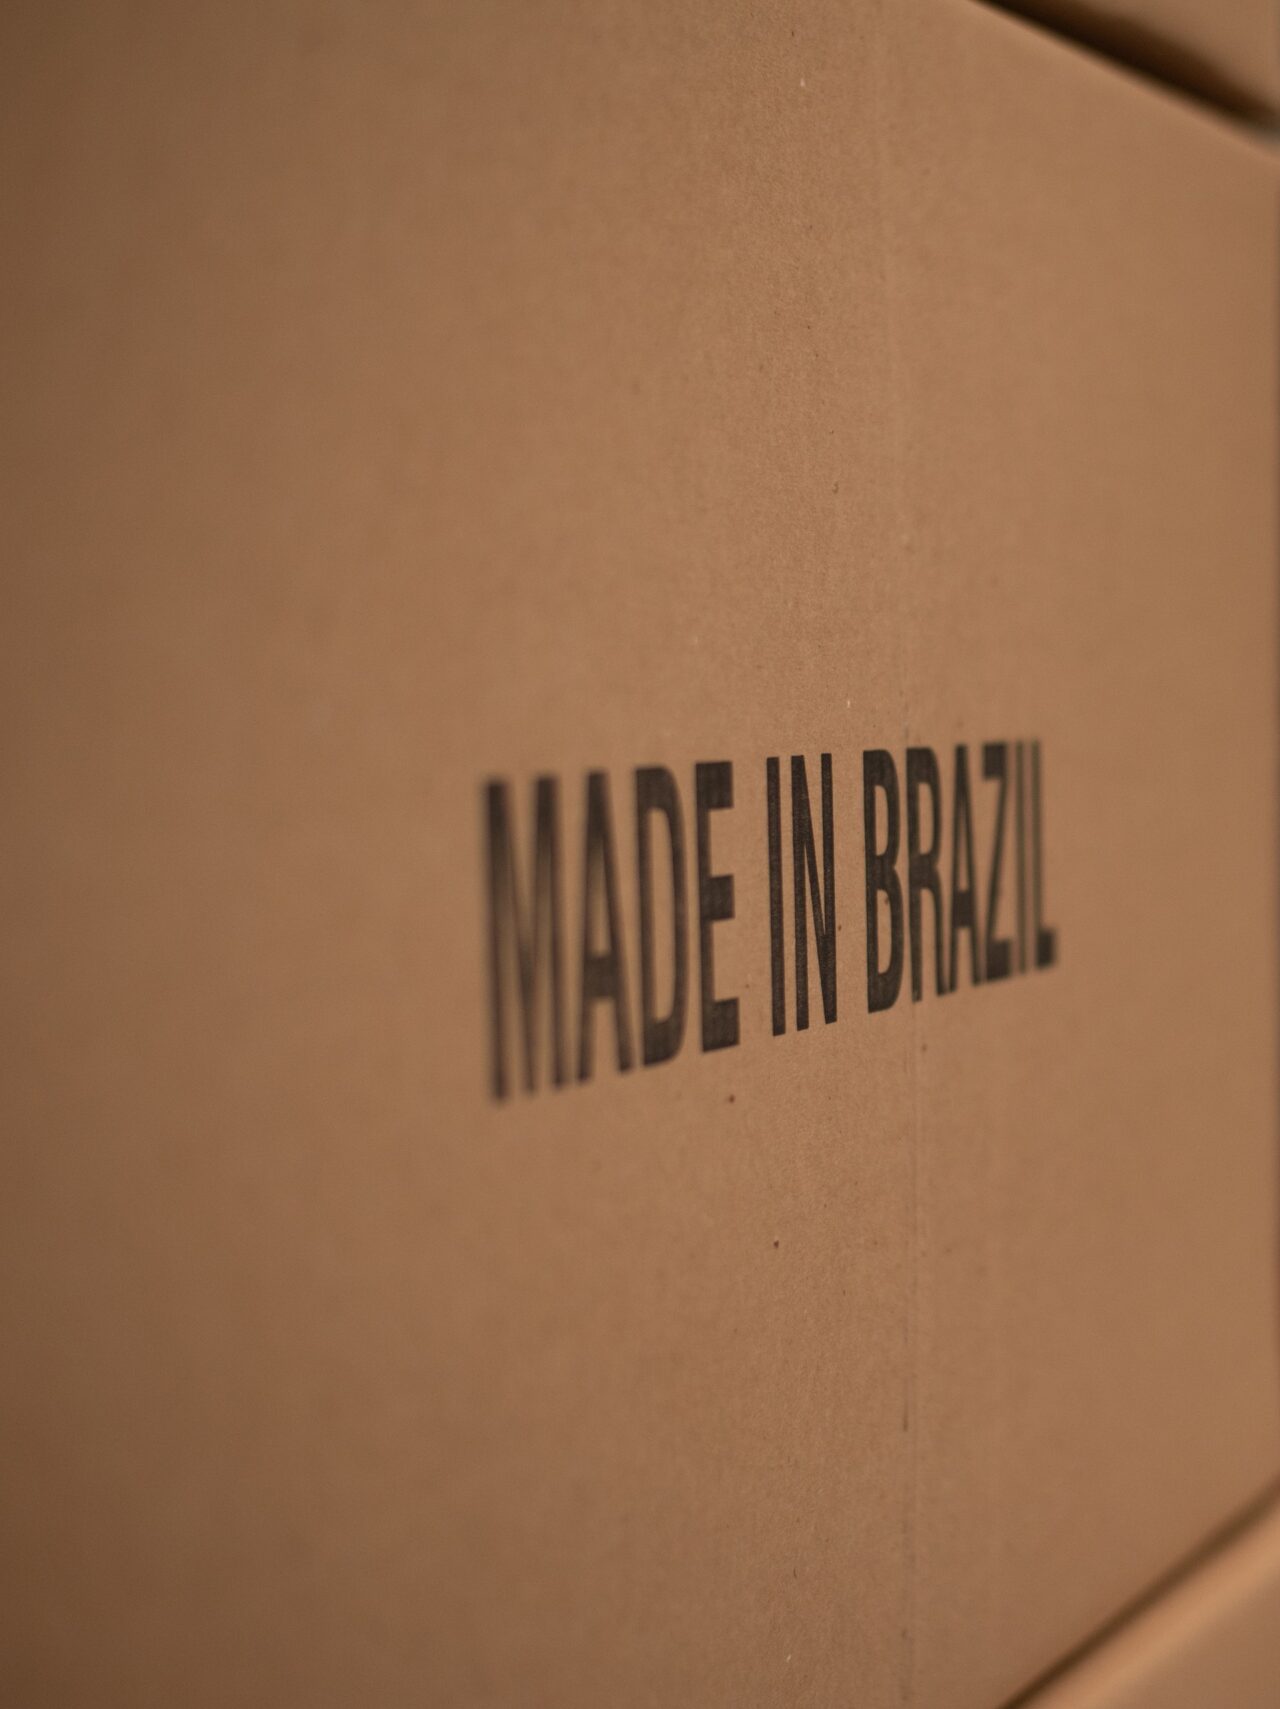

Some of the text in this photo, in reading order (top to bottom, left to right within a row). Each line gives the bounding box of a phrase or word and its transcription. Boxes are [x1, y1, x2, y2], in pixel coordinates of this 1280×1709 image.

[482, 740, 1057, 1102] MADE IN BRAZIL
